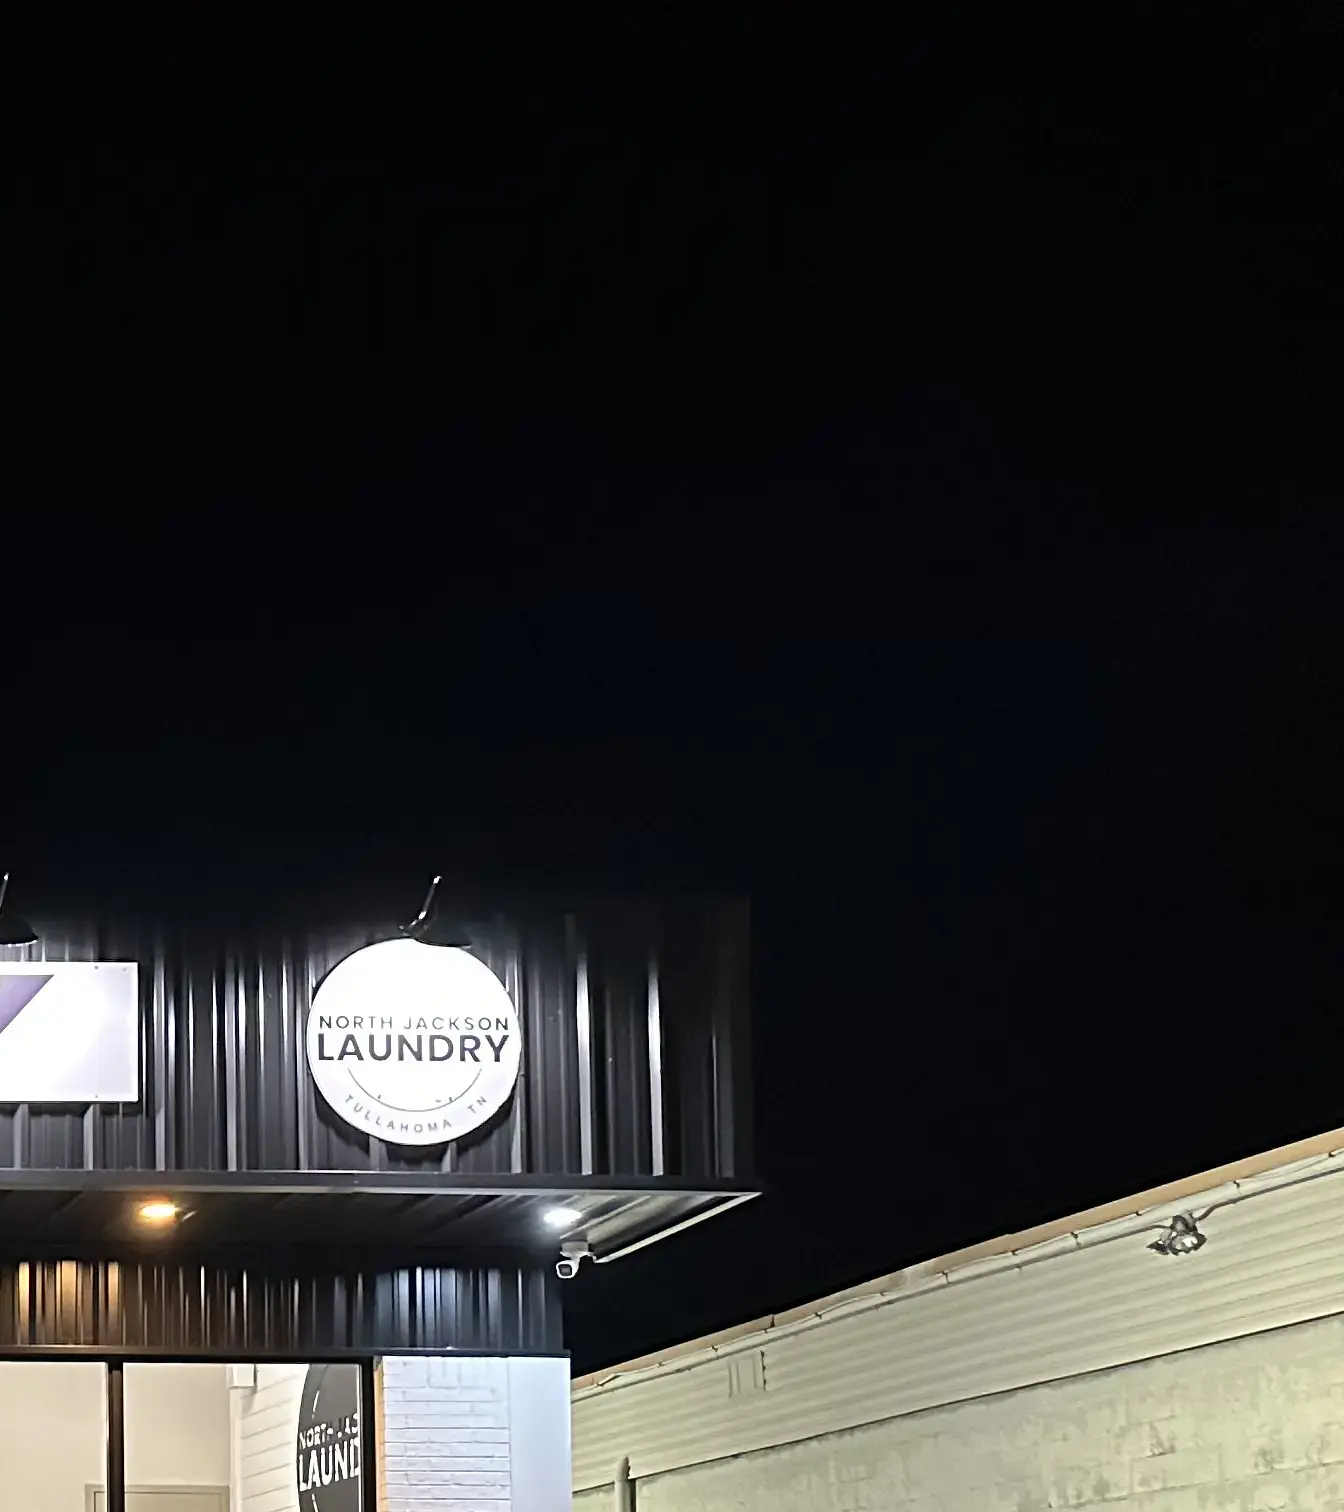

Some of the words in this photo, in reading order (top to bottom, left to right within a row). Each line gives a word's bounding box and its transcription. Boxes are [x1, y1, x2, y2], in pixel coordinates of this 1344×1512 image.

[319, 1015, 393, 1030] NORTH
[403, 1016, 509, 1031] JACKSON
[317, 1033, 510, 1063] LAUNDRY
[344, 1094, 452, 1133] TULLAHOMA
[467, 1096, 488, 1114] TN
[299, 1437, 360, 1492] LAUND
